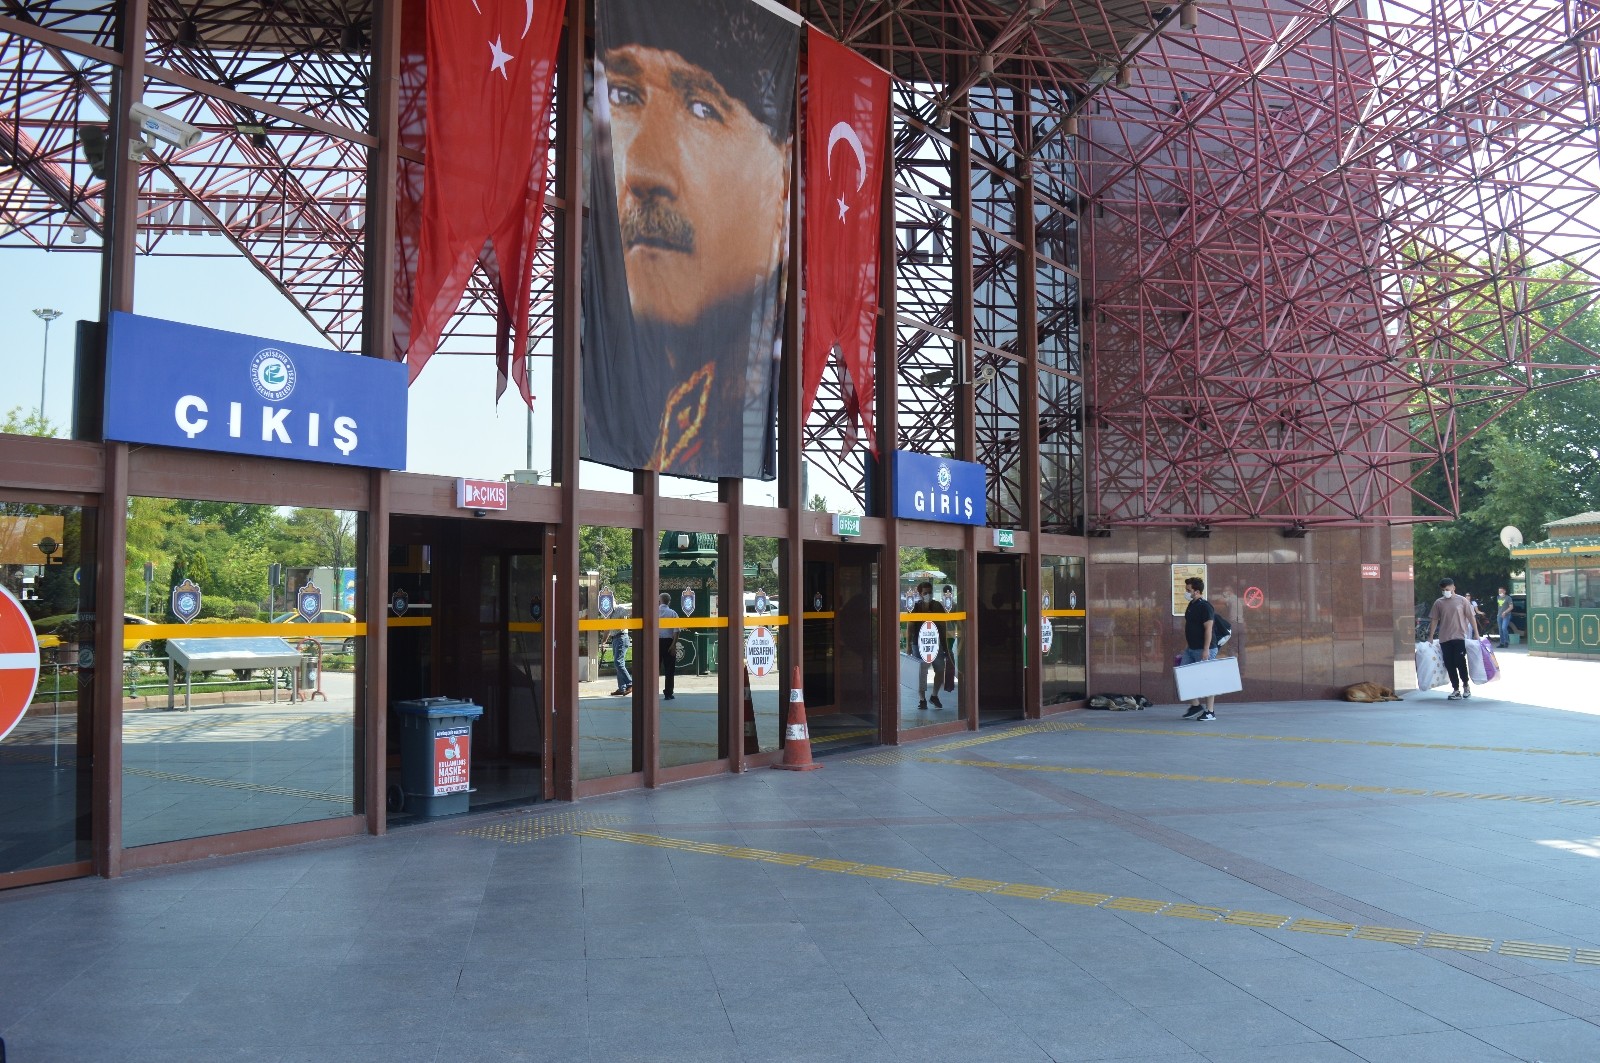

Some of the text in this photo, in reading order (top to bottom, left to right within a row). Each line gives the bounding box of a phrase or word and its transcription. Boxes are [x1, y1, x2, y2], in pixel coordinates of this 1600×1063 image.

[174, 394, 358, 456] ÇIKIŞ
[480, 486, 505, 505] ÇIKIŞ
[914, 486, 973, 520] GİRİŞ
[438, 765, 462, 777] MASKE
